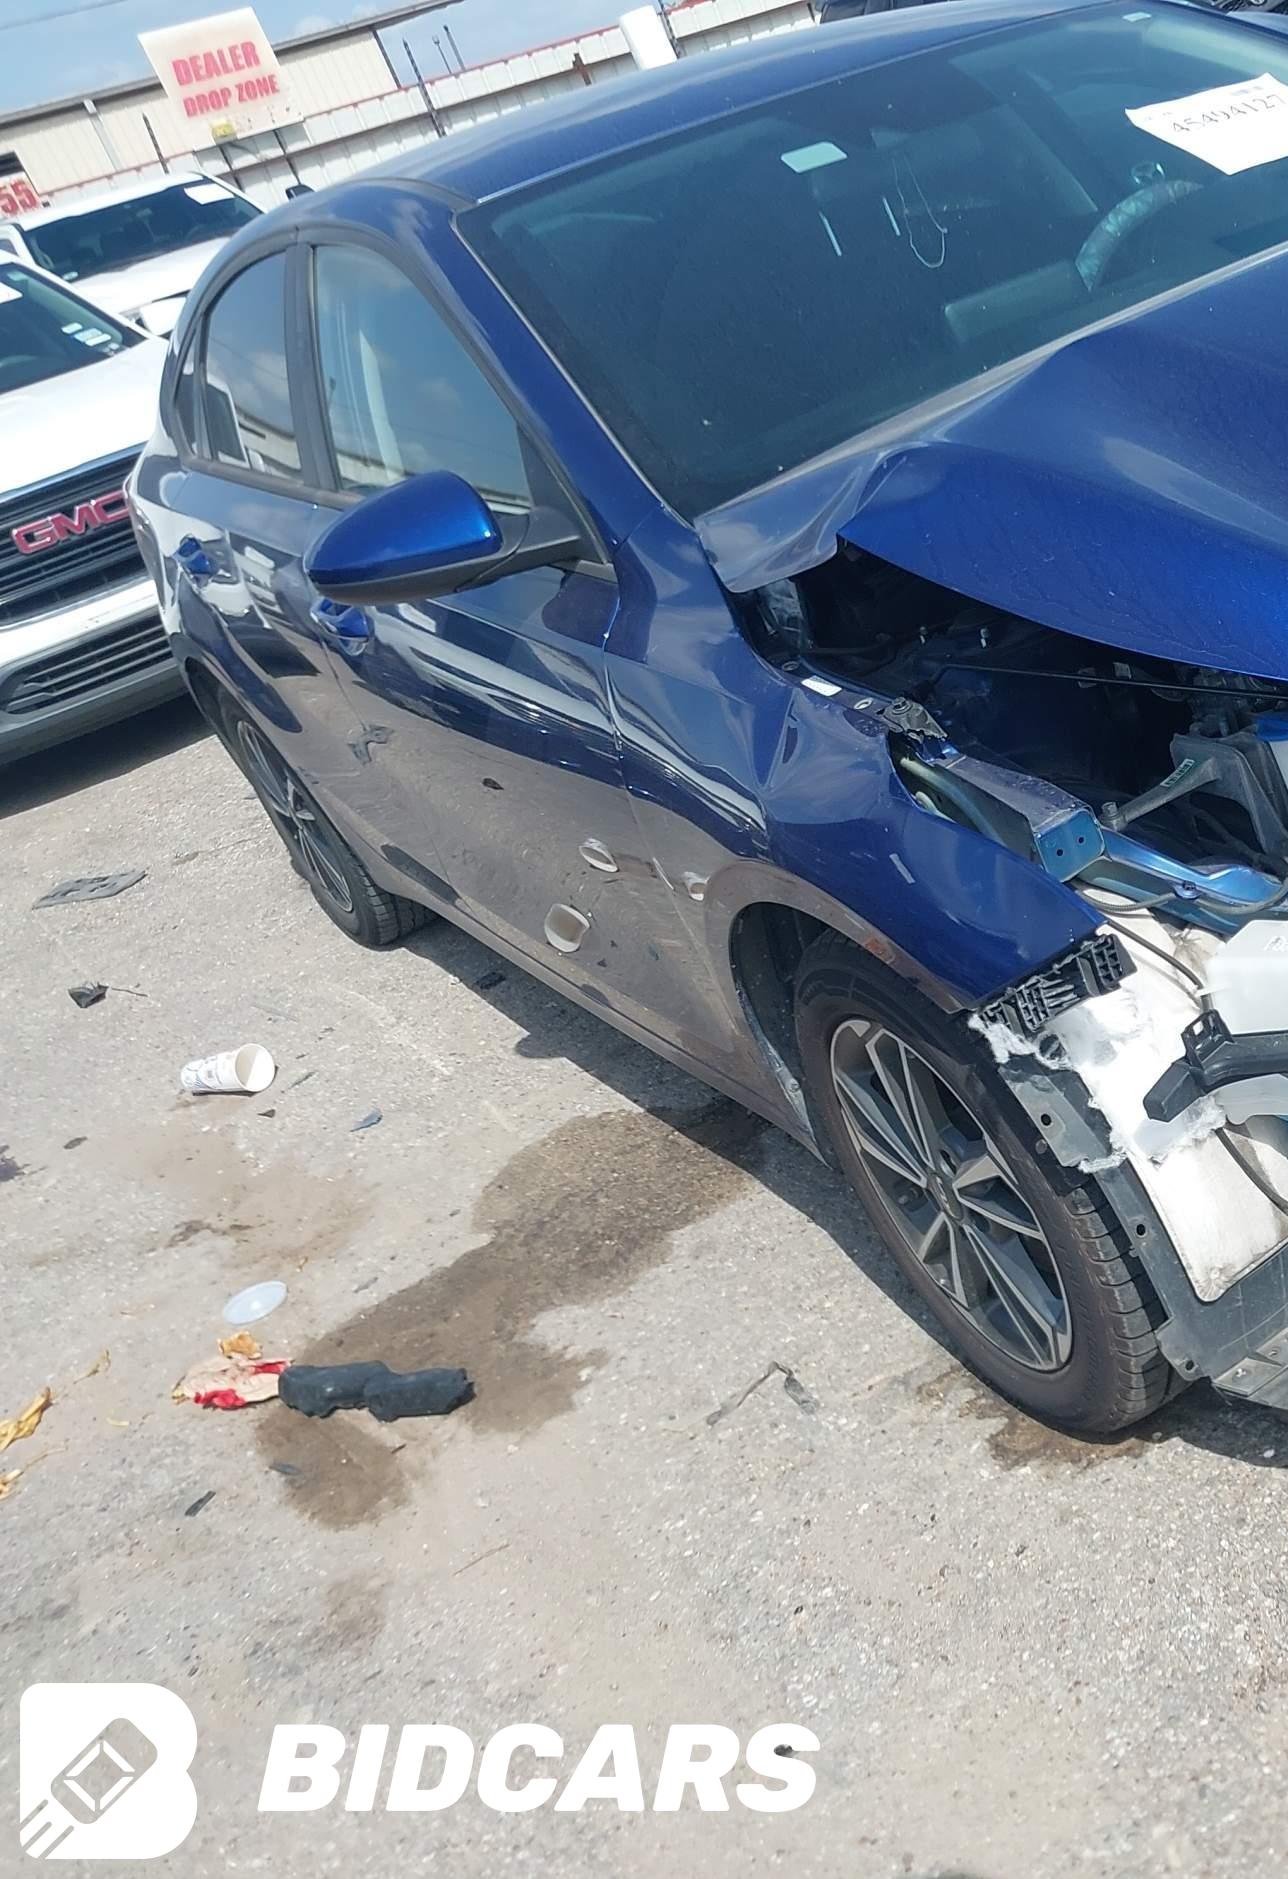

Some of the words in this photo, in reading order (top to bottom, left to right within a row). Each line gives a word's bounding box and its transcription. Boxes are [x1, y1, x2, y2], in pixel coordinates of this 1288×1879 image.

[172, 41, 261, 86] DEALER
[183, 87, 232, 118] DROP
[235, 74, 280, 102] ZONE
[11, 489, 130, 554] GMC
